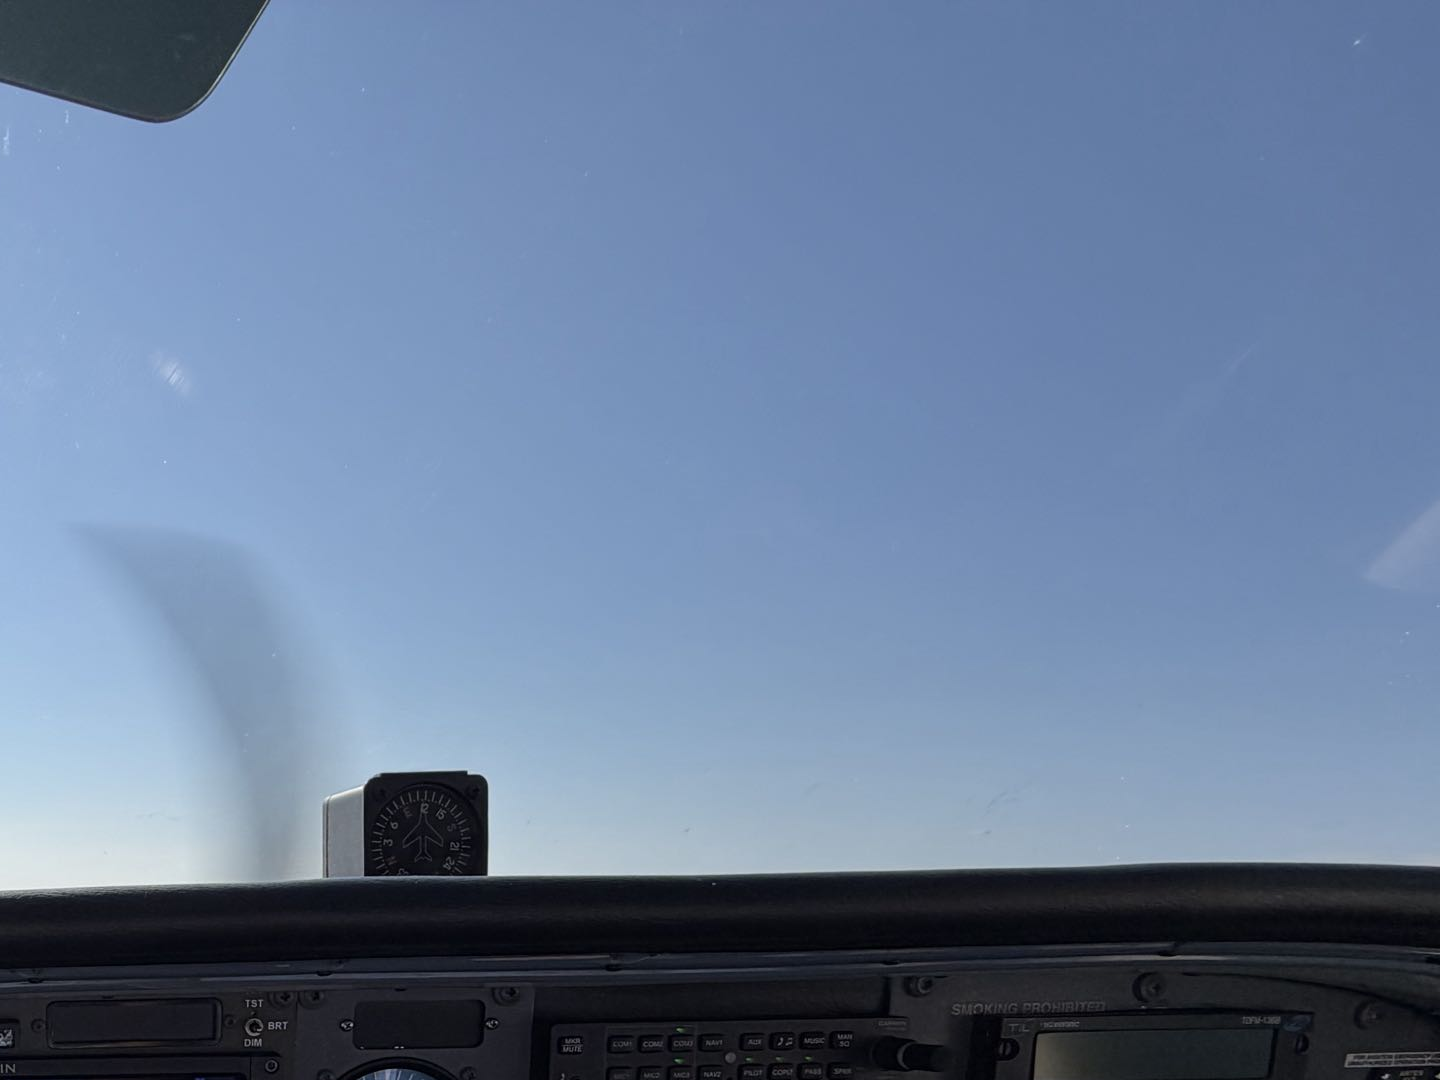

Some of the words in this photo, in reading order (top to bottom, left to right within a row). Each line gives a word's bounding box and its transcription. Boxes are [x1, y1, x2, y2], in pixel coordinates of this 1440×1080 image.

[245, 998, 264, 1008] TST
[951, 1002, 1018, 1016] SMOKING
[267, 1021, 288, 1031] BRT
[243, 1038, 263, 1047] DIM
